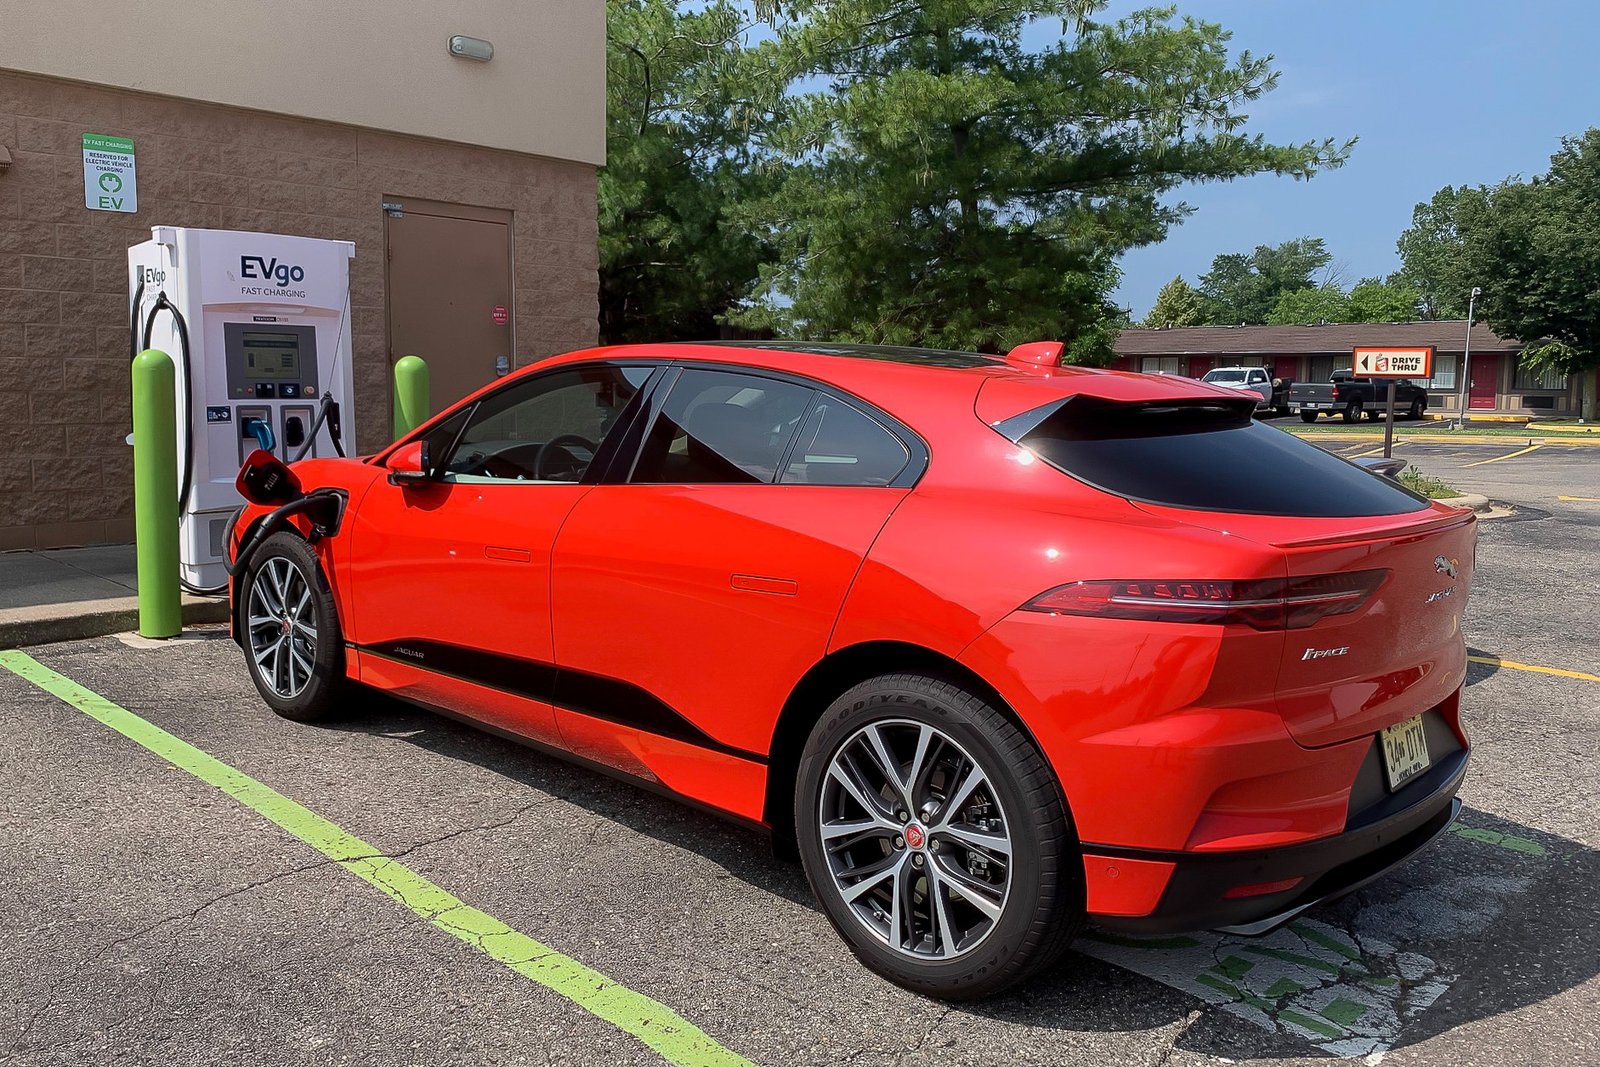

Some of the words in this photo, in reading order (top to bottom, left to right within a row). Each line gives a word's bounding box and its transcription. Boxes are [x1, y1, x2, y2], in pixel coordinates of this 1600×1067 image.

[91, 139, 104, 147] FAST
[105, 141, 133, 150] CHARGING
[89, 152, 117, 160] RESERVED
[85, 158, 111, 166] ELECTRIC
[111, 160, 133, 168] VEHICLE
[96, 165, 123, 173] CHARGING
[146, 267, 166, 286] EVgo
[240, 255, 305, 287] EVgo
[241, 287, 262, 296] FAST
[263, 287, 306, 298] CHARGING
[394, 646, 425, 659] JAGUAR
[817, 694, 947, 744] GOODYEAR
